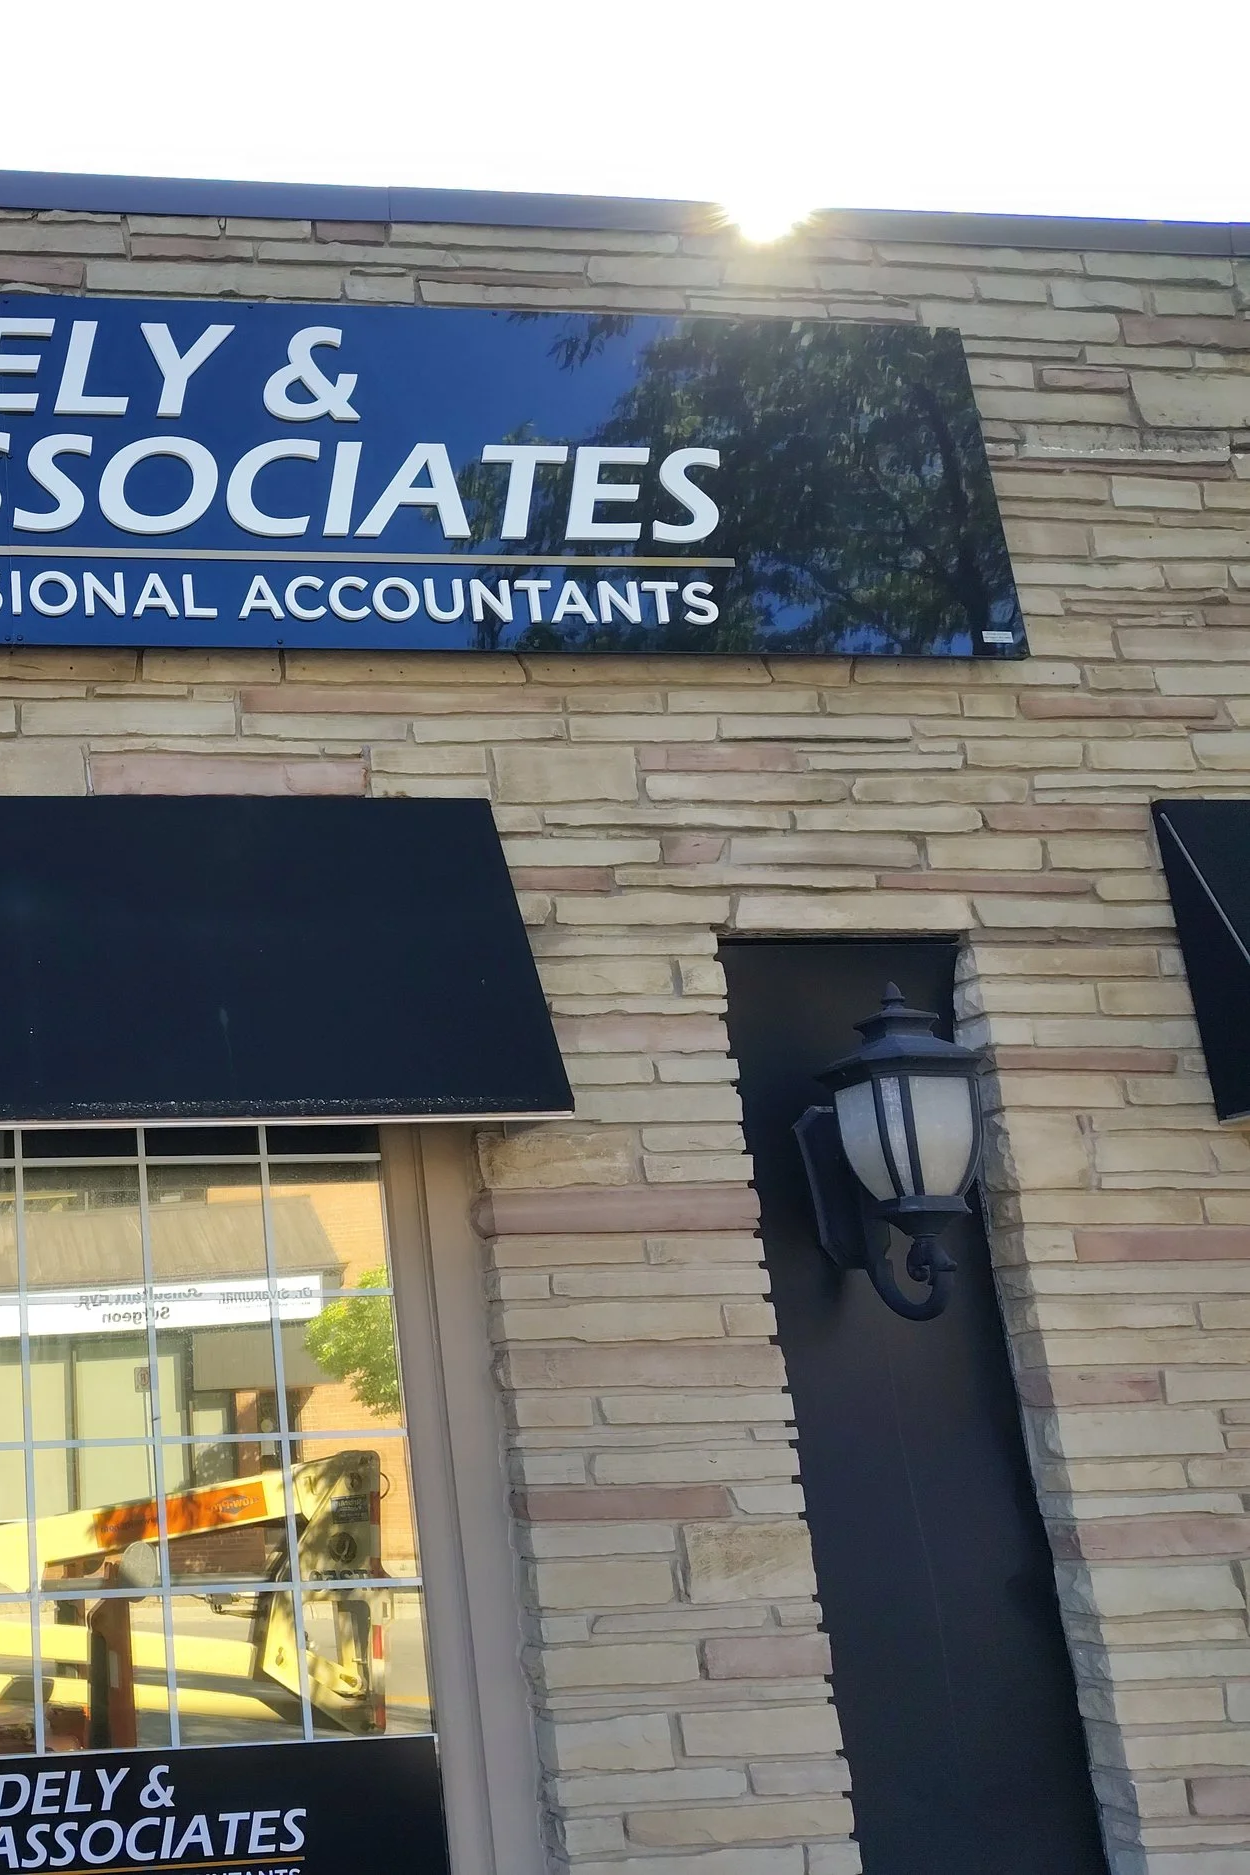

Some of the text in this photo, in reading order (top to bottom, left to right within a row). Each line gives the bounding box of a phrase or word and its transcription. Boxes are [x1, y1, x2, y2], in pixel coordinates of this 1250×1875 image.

[263, 326, 362, 422] &
[238, 574, 720, 627] ACCOUNTANTS
[139, 1764, 176, 1809] &
